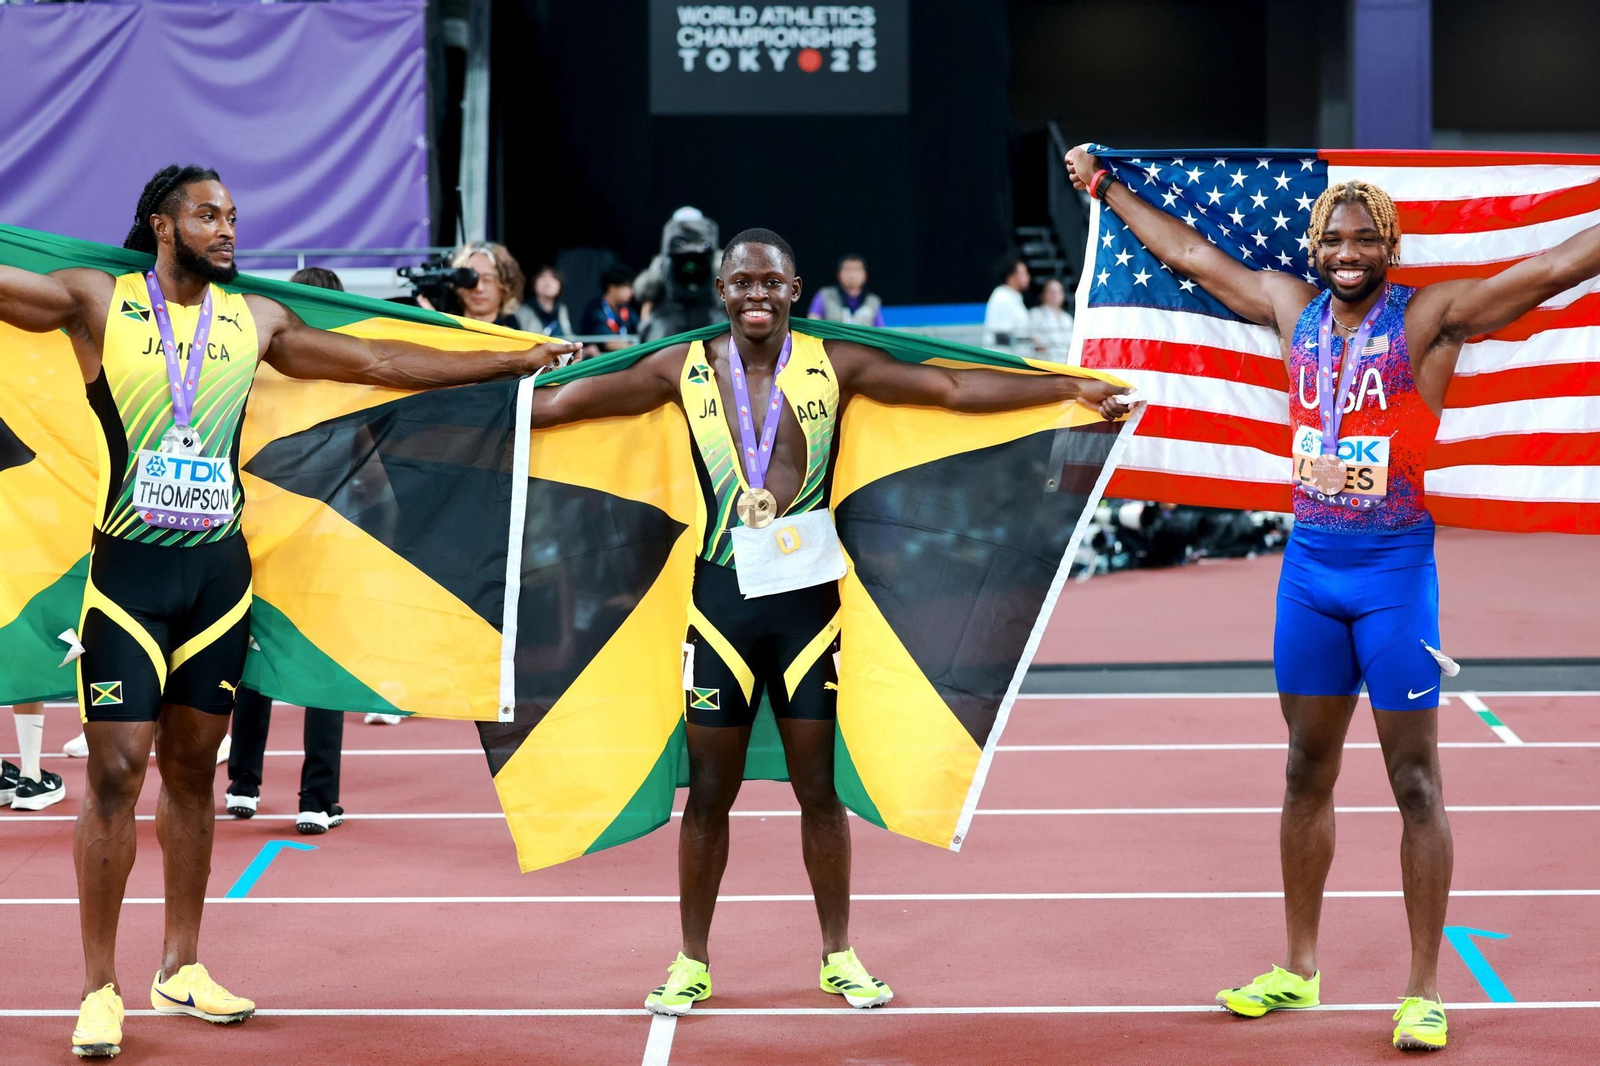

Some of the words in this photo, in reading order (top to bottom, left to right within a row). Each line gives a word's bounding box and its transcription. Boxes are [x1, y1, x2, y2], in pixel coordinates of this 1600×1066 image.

[677, 6, 757, 26] WORLD
[759, 6, 876, 26] ATHLETICS
[677, 27, 876, 48] CHAMPIONSHIPS
[142, 337, 229, 362] JAMCA
[1316, 435, 1380, 463] DK
[167, 457, 226, 483] TDK
[1299, 458, 1374, 491] LES
[140, 481, 229, 511] THOMPSON
